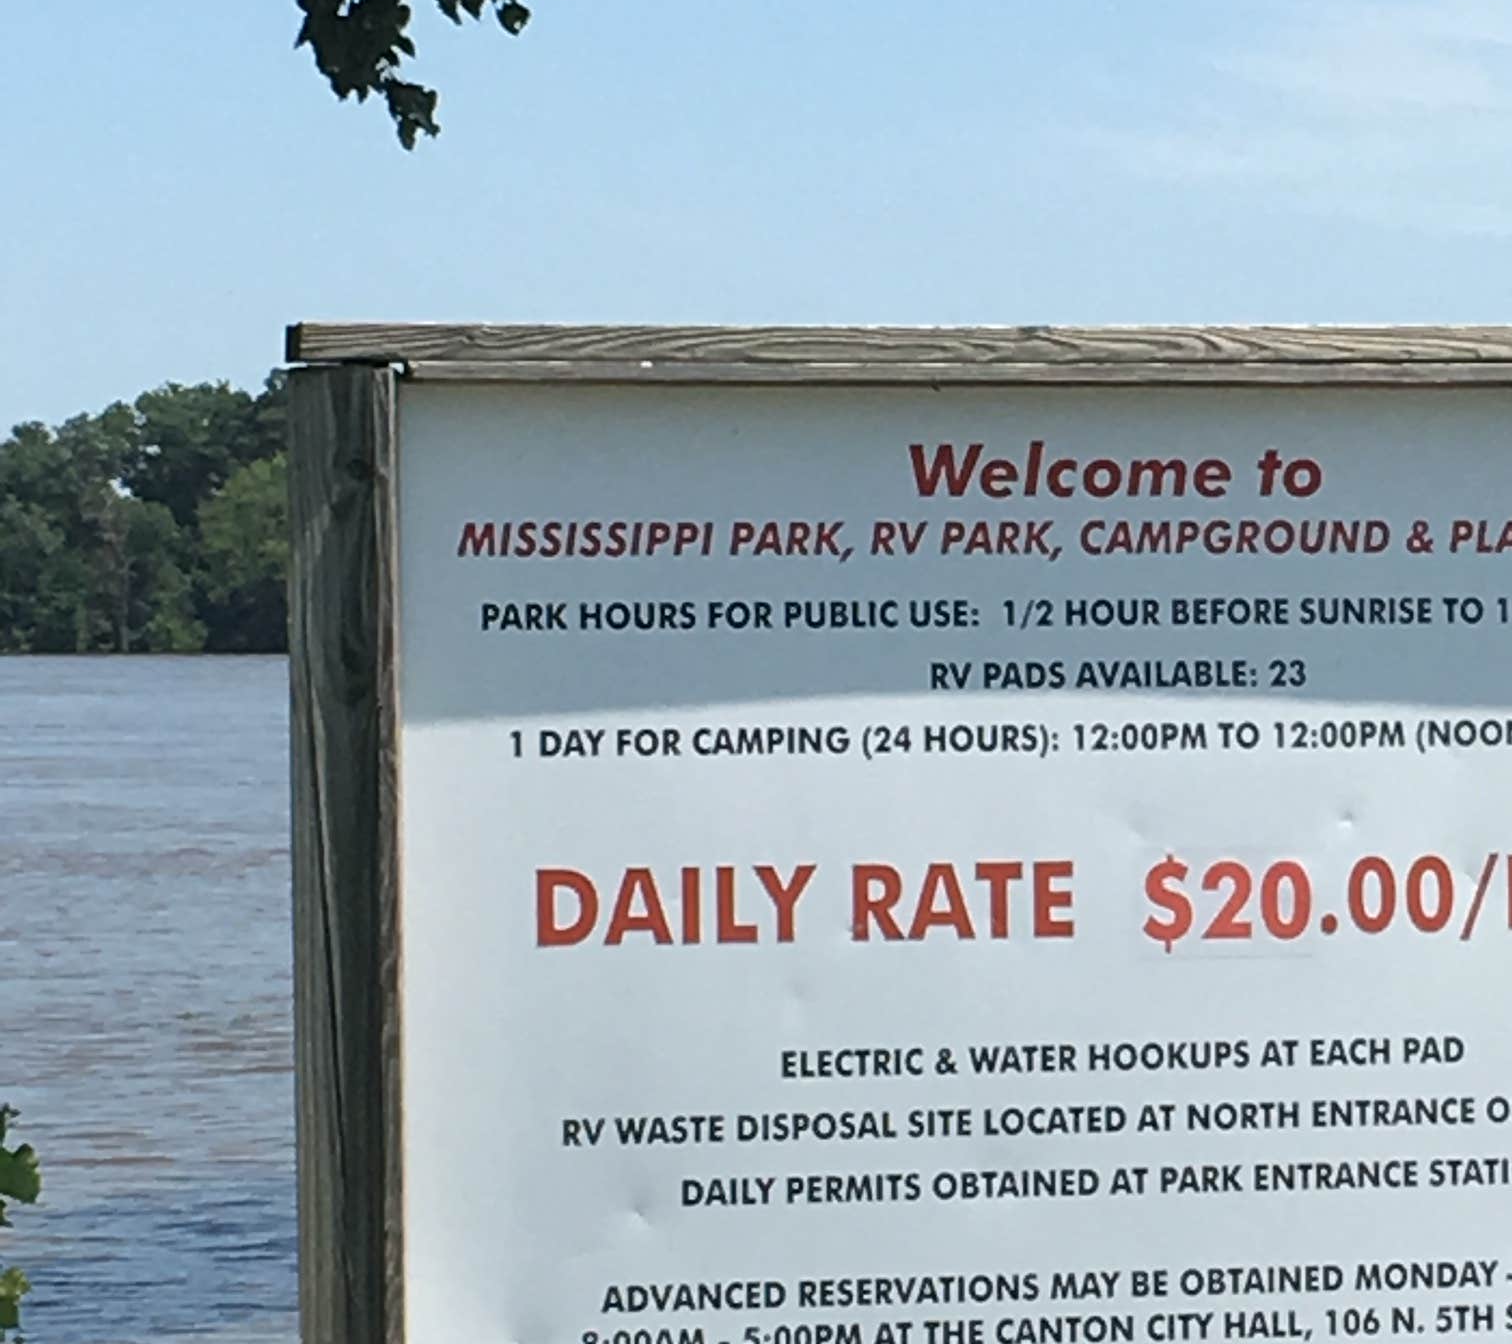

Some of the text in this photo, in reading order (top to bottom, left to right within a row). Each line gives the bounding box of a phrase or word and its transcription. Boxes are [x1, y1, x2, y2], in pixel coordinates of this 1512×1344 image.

[908, 440, 1322, 498] Welcome to
[457, 521, 714, 558] MISSISSIPPI
[729, 521, 854, 563] PARK,
[870, 520, 929, 556] RV
[940, 520, 1063, 562] PARK,
[1080, 519, 1390, 556] CAMPGROUND
[1406, 520, 1434, 554] &
[481, 603, 568, 631] PARK
[579, 601, 696, 630] HOURS
[708, 601, 773, 629] FOR
[784, 600, 899, 629] PUBLIC
[909, 599, 980, 628] USE:
[1003, 599, 1054, 629] 1/2
[1065, 599, 1160, 627] HOUR
[1171, 598, 1289, 625] BEFORE
[1300, 597, 1432, 625] SUNRISE
[1442, 597, 1484, 625] TO
[931, 659, 1307, 690] RV PADS AVAILABLE: 23
[511, 730, 522, 758] 1
[539, 729, 605, 757] DAY
[616, 728, 681, 757] FOR
[692, 726, 850, 756] CAMPING
[862, 725, 912, 761] (24
[924, 724, 1059, 758] HOURS):
[1073, 722, 1207, 751] 12:00PM
[1217, 721, 1260, 749] TO
[1274, 720, 1406, 749] 12:00PM
[536, 864, 817, 948] DAILY
[851, 860, 1074, 942] RATE
[781, 1036, 1464, 1078] ELECTRIC & WATER HOOKUPS AT EACH PAD
[563, 1118, 605, 1147] RV
[614, 1115, 724, 1145] WASTE
[737, 1111, 897, 1142] DISPOSAL
[908, 1109, 972, 1138] SITE
[984, 1106, 1127, 1136] LOCATED
[1137, 1104, 1176, 1132] AT
[1187, 1101, 1299, 1131] NORTH
[1312, 1097, 1475, 1128] ENTRANCE
[681, 1177, 775, 1207] DAILY
[786, 1173, 921, 1204] PERMITS
[932, 1169, 1100, 1200] OBTAINED
[1110, 1167, 1149, 1195] AT
[1160, 1164, 1243, 1194] PARK
[1254, 1160, 1418, 1192] ENTRANCE
[601, 1281, 786, 1314] ADVANCED
[798, 1273, 1039, 1308] RESERVATIONS
[1050, 1271, 1120, 1300] MAY
[1131, 1270, 1168, 1297] BE
[1179, 1265, 1343, 1296] OBTAINED
[1355, 1260, 1498, 1291] MONDAY
[1147, 1312, 1214, 1342] CITY
[1224, 1310, 1312, 1341] HALL,
[1326, 1308, 1381, 1336] 106
[1392, 1306, 1425, 1334] N.
[1436, 1304, 1494, 1333] 5TH
